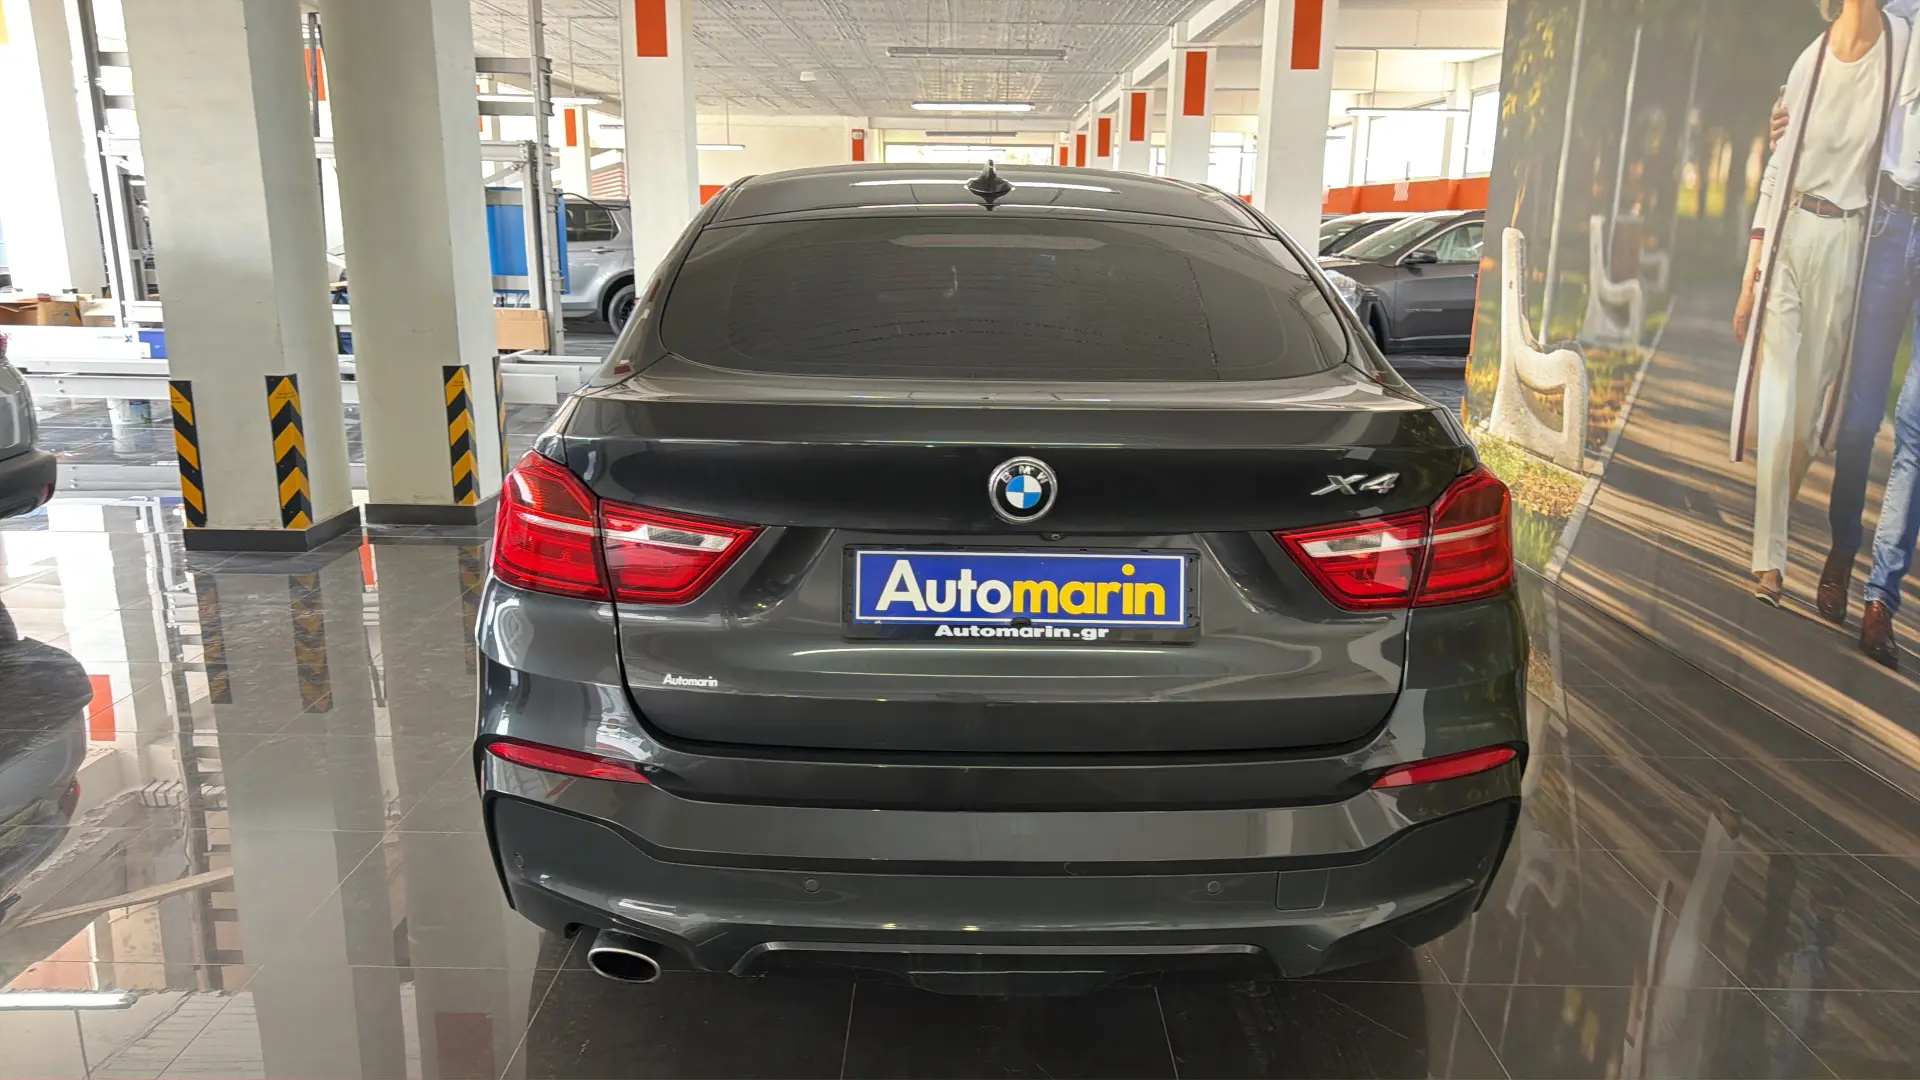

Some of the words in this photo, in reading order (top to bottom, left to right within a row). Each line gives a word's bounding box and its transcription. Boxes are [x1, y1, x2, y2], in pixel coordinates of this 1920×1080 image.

[1001, 465, 1049, 484] BMW
[1310, 472, 1400, 495] X4
[875, 559, 1166, 615] Automarin
[934, 625, 1110, 640] Automarin.gr
[662, 673, 718, 687] Automarin
